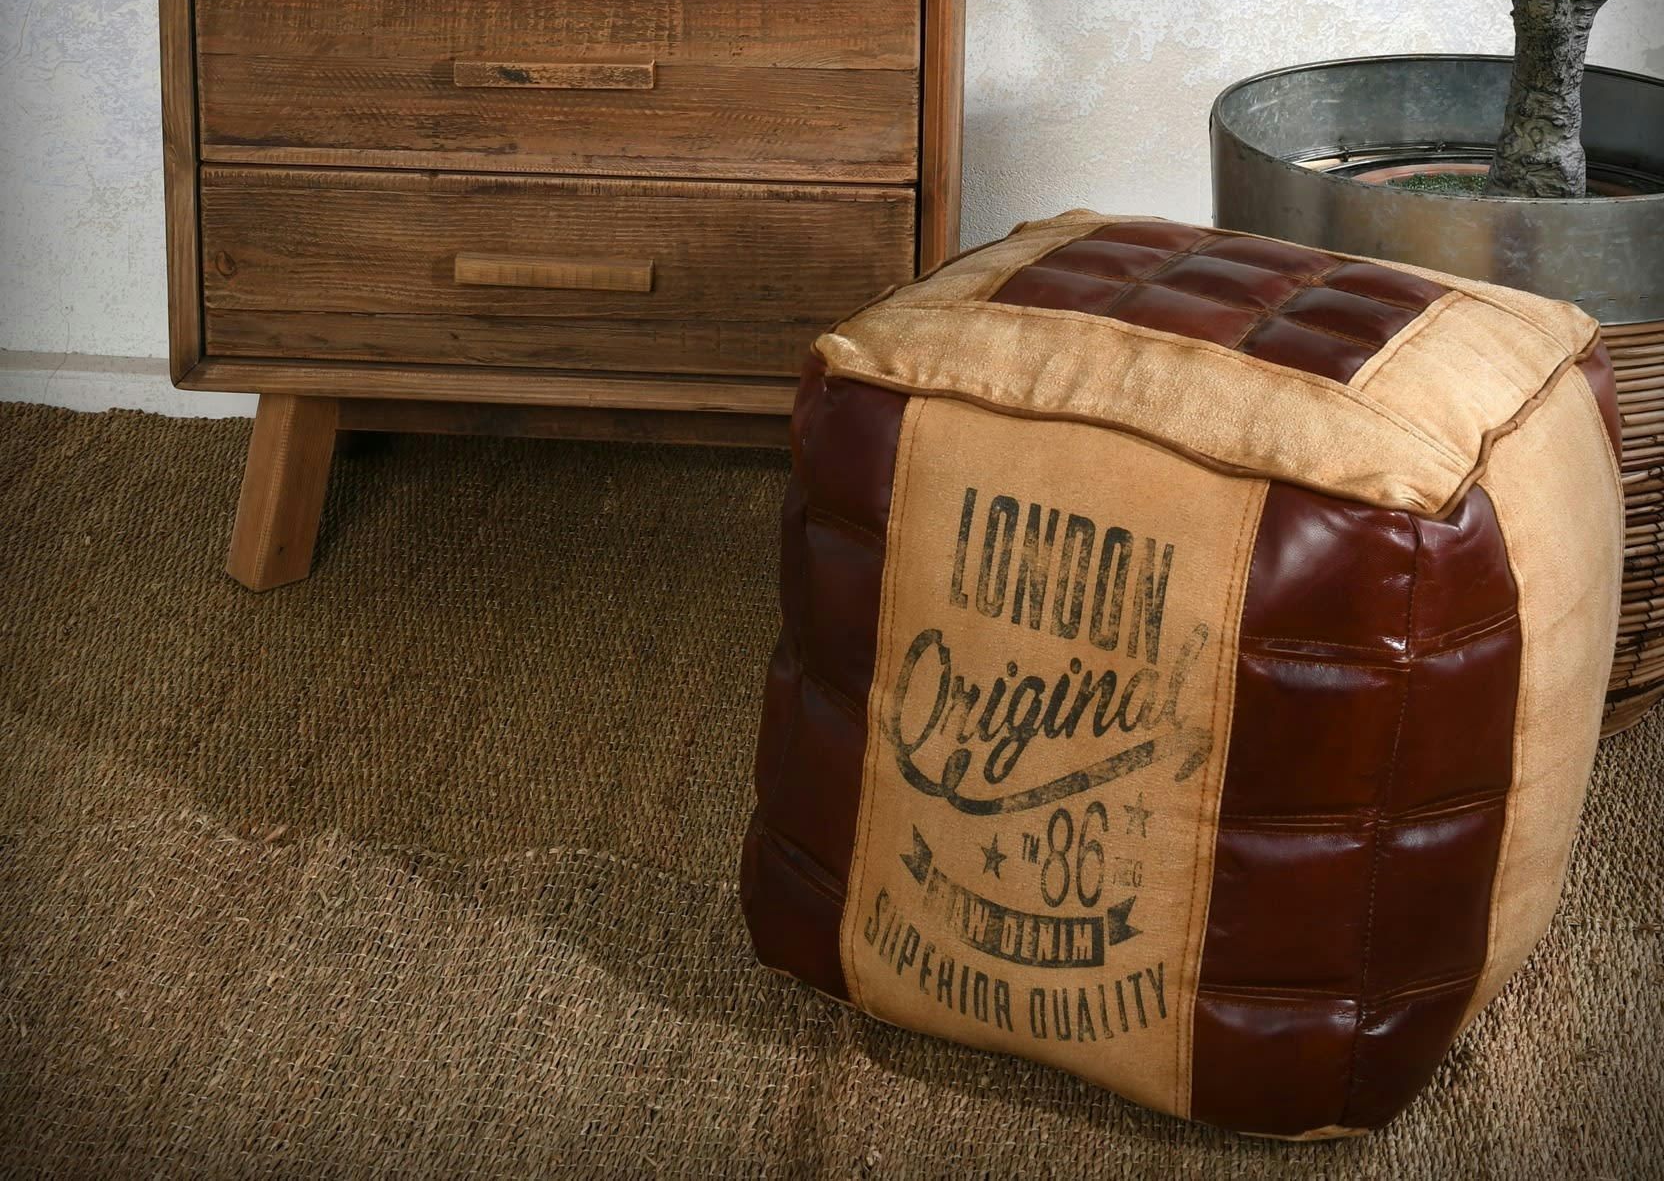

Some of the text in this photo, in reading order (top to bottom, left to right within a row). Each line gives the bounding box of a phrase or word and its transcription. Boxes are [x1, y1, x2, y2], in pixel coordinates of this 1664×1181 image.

[949, 486, 1175, 665] LONDON
[888, 622, 1212, 814] Original
[1041, 800, 1109, 908] 86
[863, 886, 1167, 1042] SUPERIOR QUALITY
[1000, 914, 1093, 962] DENIM
